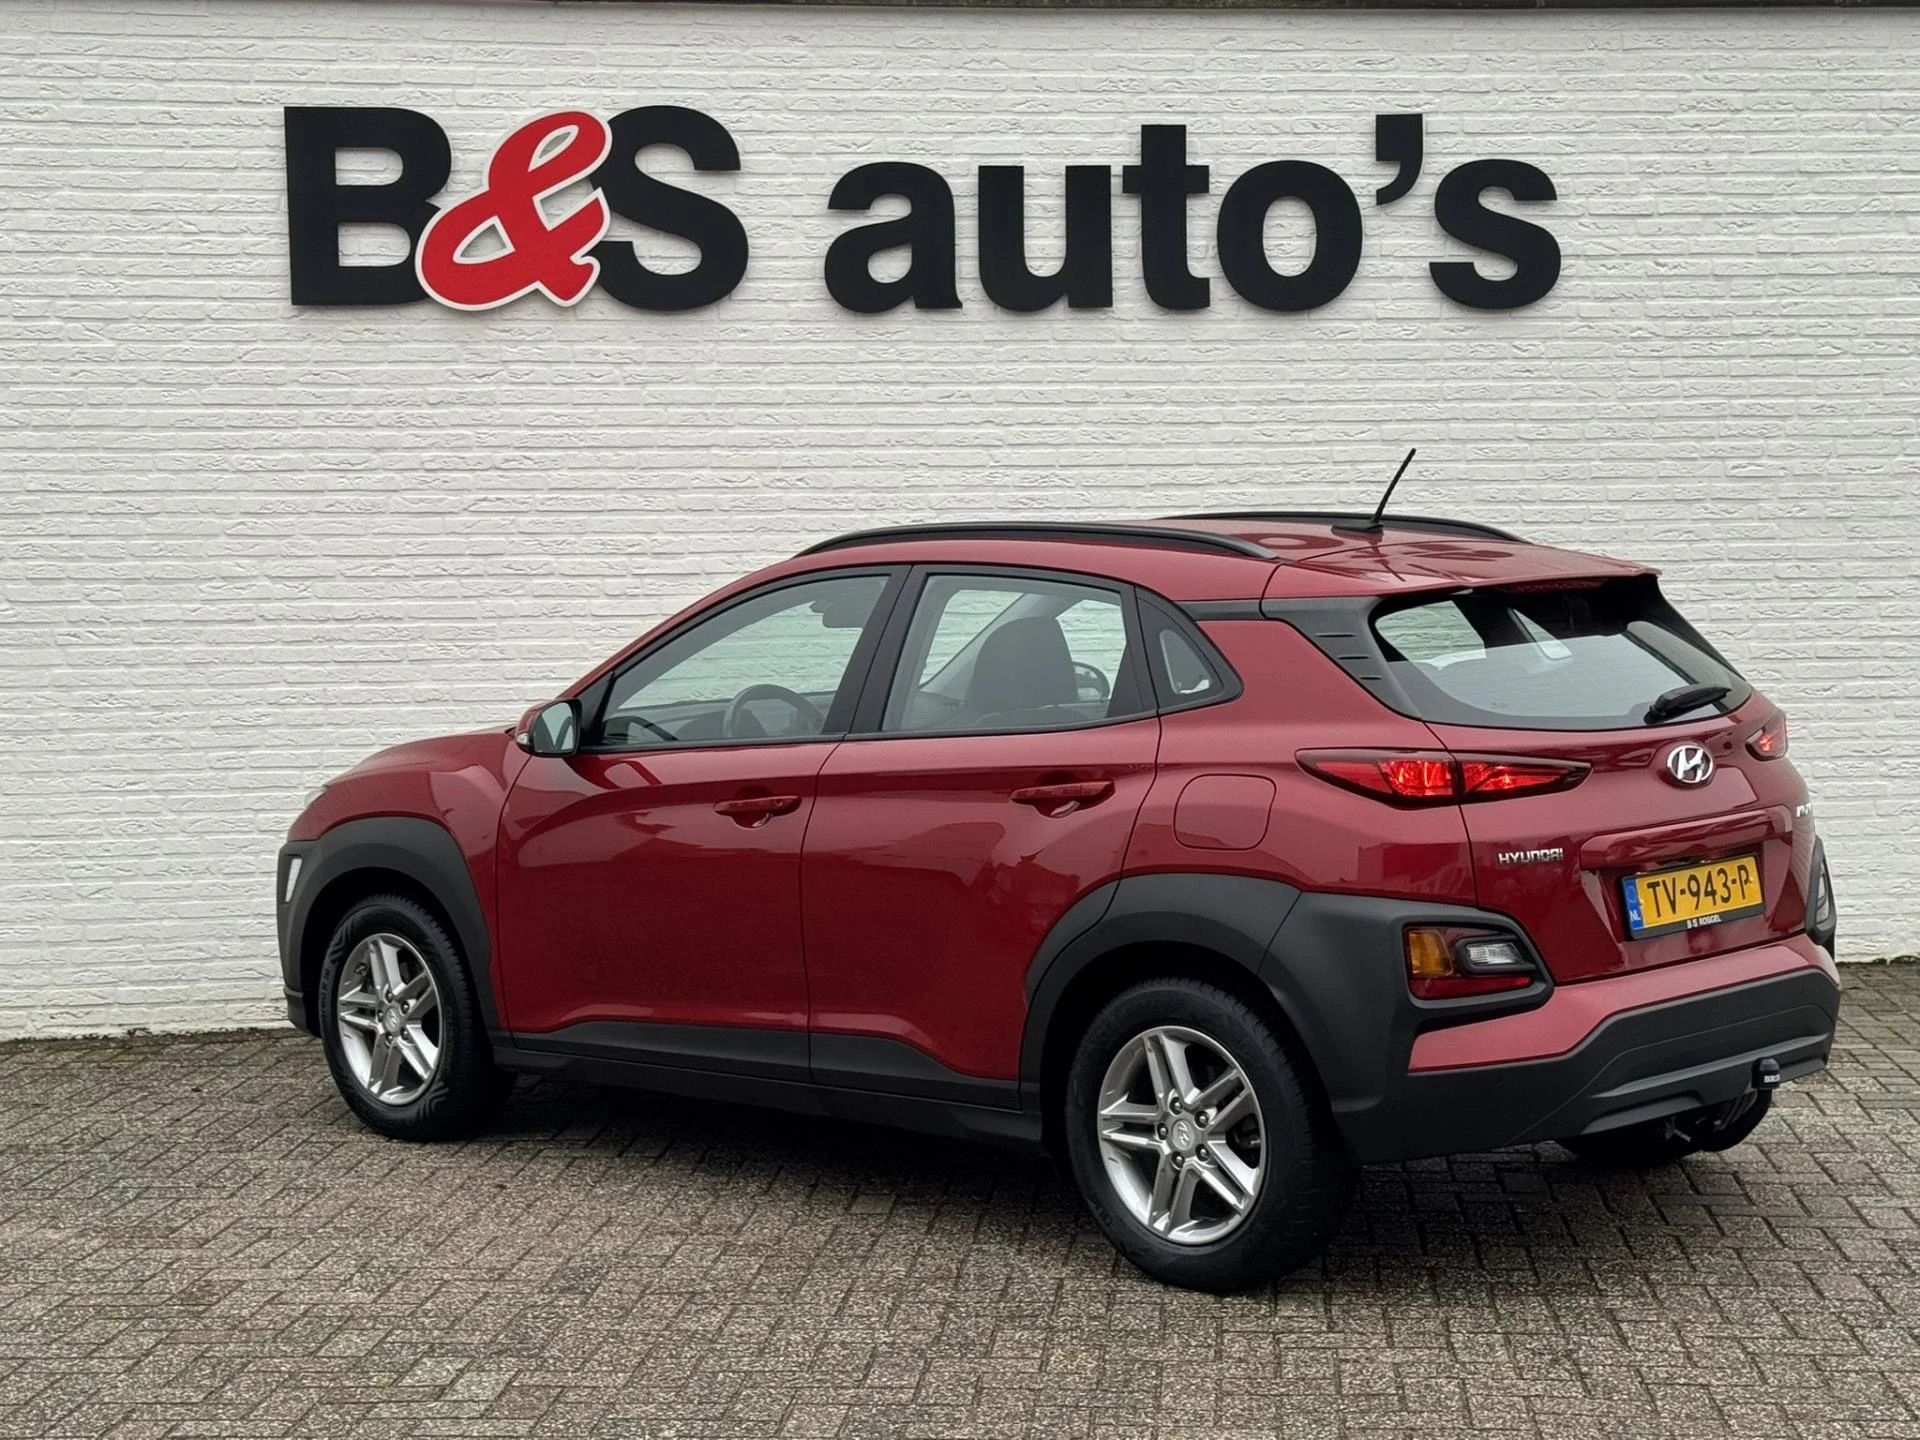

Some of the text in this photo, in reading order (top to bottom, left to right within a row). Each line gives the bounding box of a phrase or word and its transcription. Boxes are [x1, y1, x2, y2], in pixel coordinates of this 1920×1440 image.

[284, 105, 1561, 313] B&S auto's
[1498, 847, 1564, 864] HYUNDAI
[1646, 863, 1752, 918] TV-943-P
[1629, 910, 1641, 921] NL
